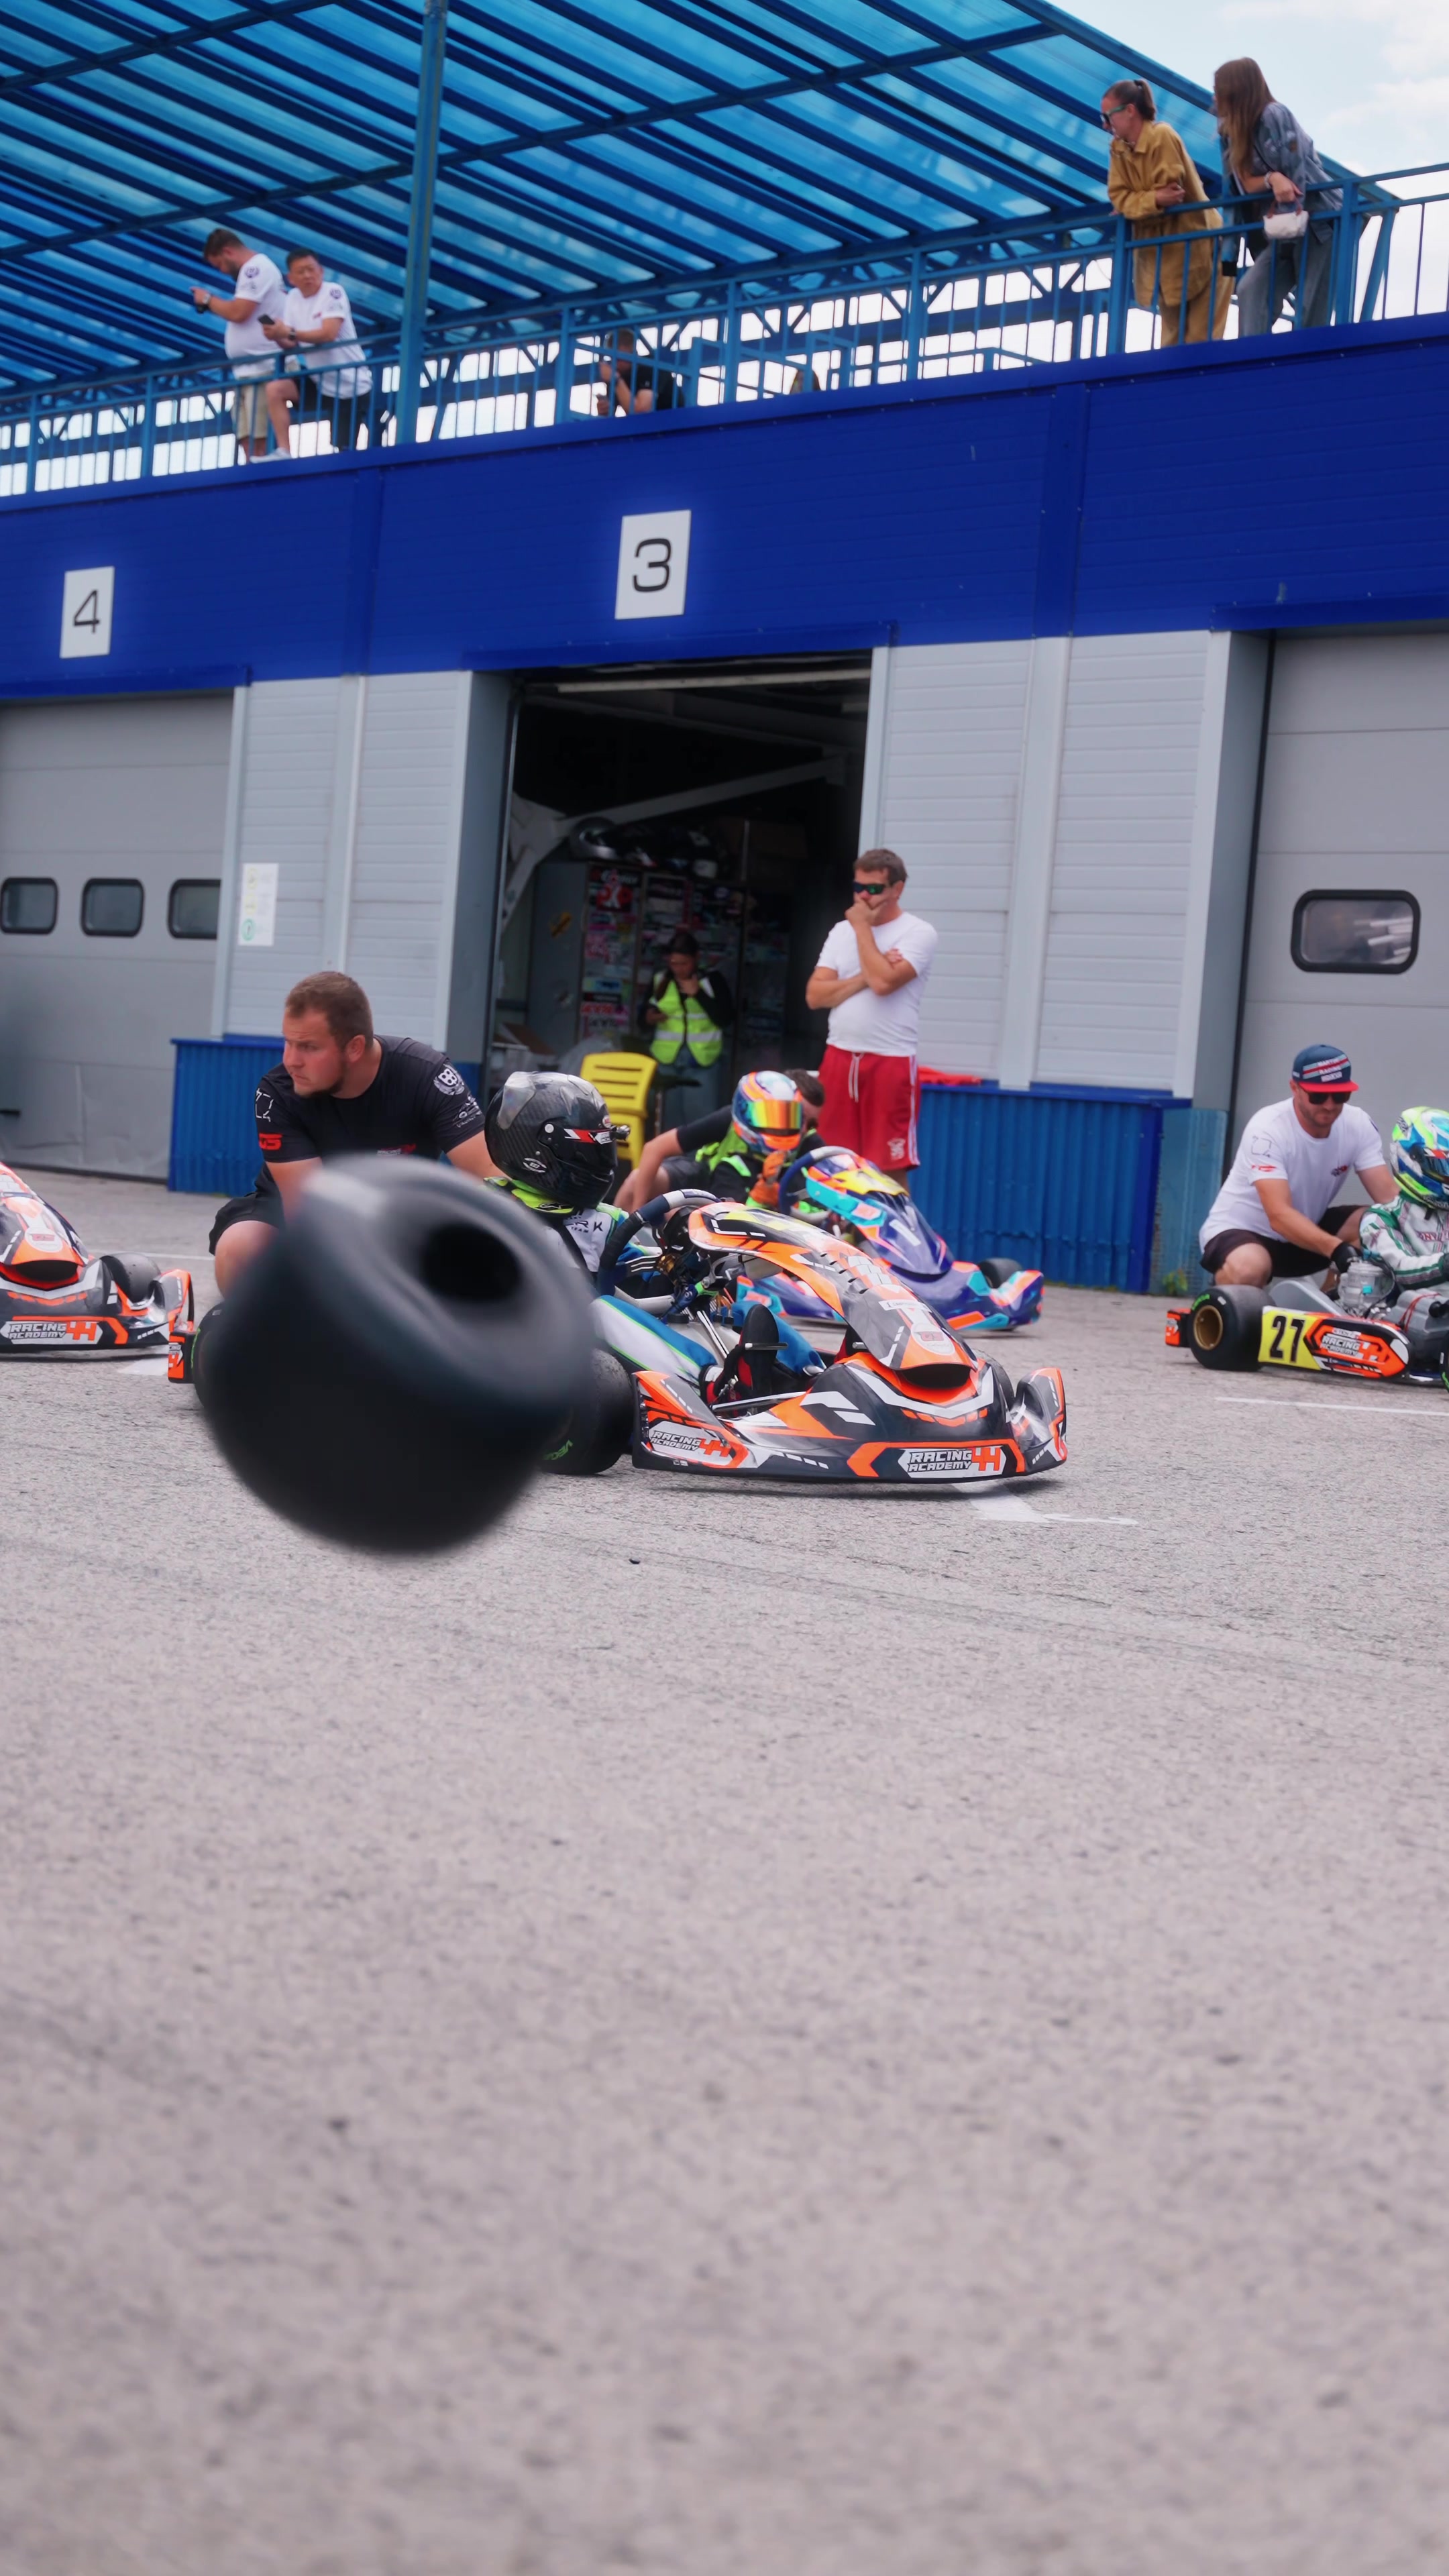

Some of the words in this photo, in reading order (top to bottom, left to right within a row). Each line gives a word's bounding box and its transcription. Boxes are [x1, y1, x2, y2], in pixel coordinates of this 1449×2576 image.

[633, 538, 672, 592] 3
[73, 590, 99, 634] 4
[8, 1331, 66, 1340] ACADEMY
[9, 1323, 67, 1333] RACING
[1270, 1316, 1305, 1363] 27
[1322, 1335, 1360, 1351] RACING
[650, 1438, 699, 1452] ACADEMY
[652, 1430, 703, 1448] RACING
[910, 1449, 972, 1464] RACING
[908, 1460, 972, 1472] ACADEMY
